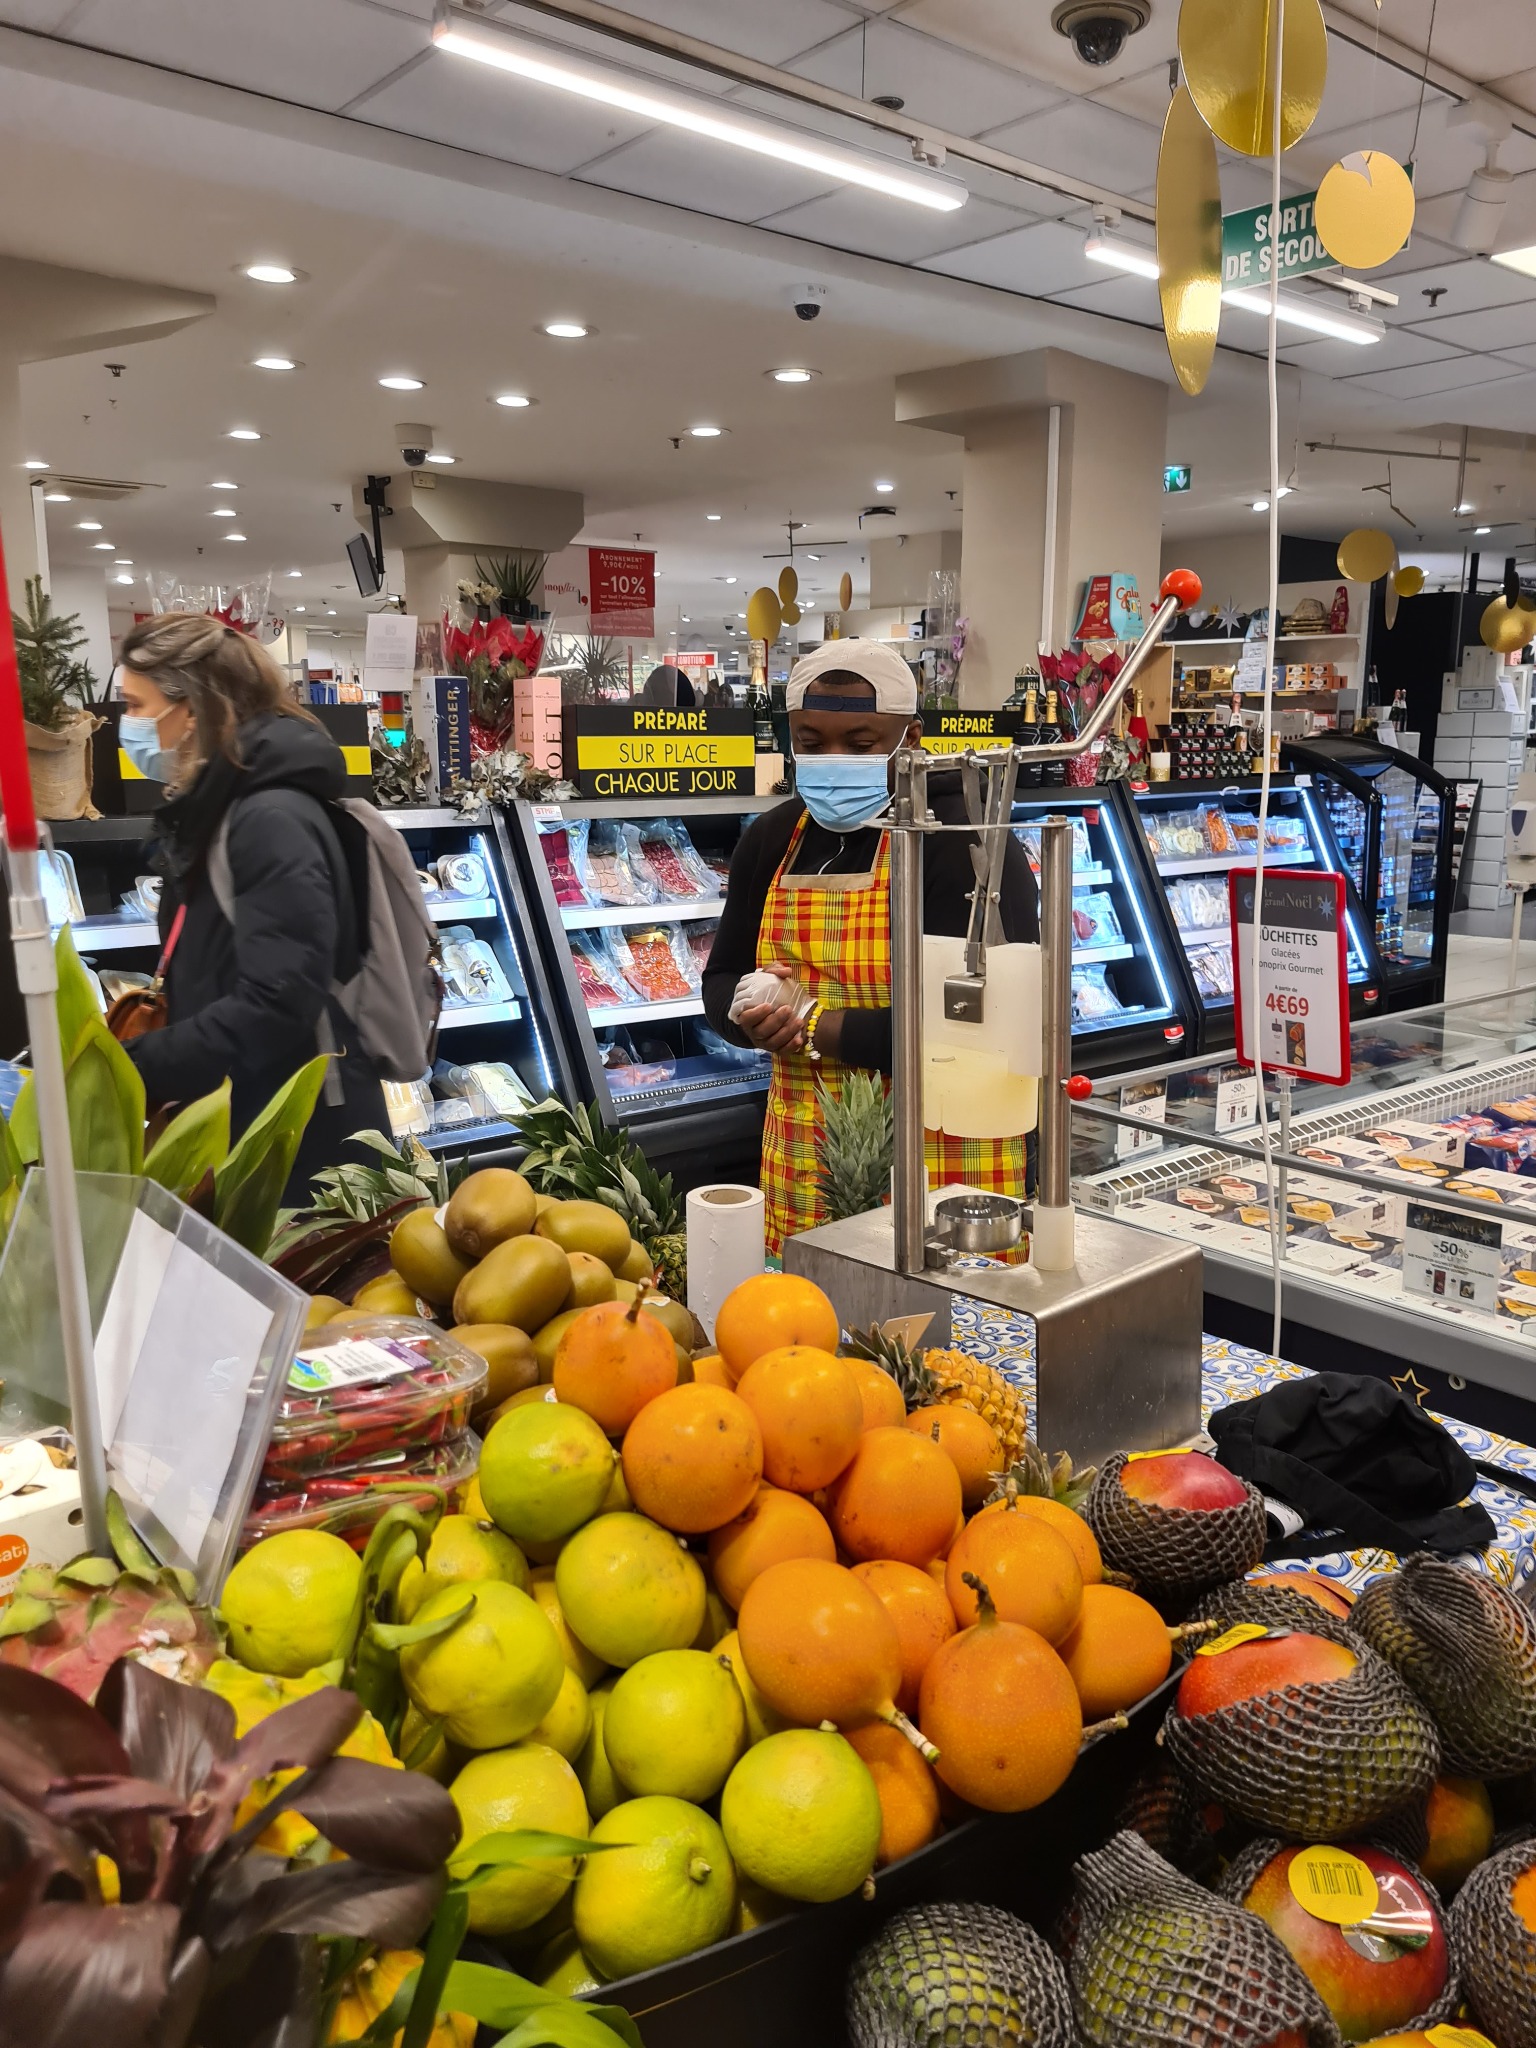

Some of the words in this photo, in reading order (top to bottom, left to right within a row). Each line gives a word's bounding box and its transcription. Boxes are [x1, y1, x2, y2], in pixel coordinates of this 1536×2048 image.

[1254, 201, 1317, 242] SORTI
[1225, 251, 1252, 281] DE
[1258, 234, 1328, 273] SECOU
[600, 575, 646, 595] -10%
[633, 708, 708, 731] PRÉPARÉ
[941, 714, 995, 734] PRÉPARÉ
[447, 689, 462, 782] AITTINGER
[619, 743, 655, 763] SUR
[664, 743, 718, 764] PLACE
[594, 771, 680, 795] CHAQUE
[688, 770, 737, 793] JOUR
[1286, 892, 1313, 910] Noël
[1259, 926, 1319, 947] ÛCHETTES
[1271, 947, 1301, 960] Glacées
[1251, 957, 1288, 971] onoprix
[1288, 963, 1324, 976] Gourmet
[1265, 991, 1310, 1017] 4€69
[1433, 1240, 1469, 1260] -50%
